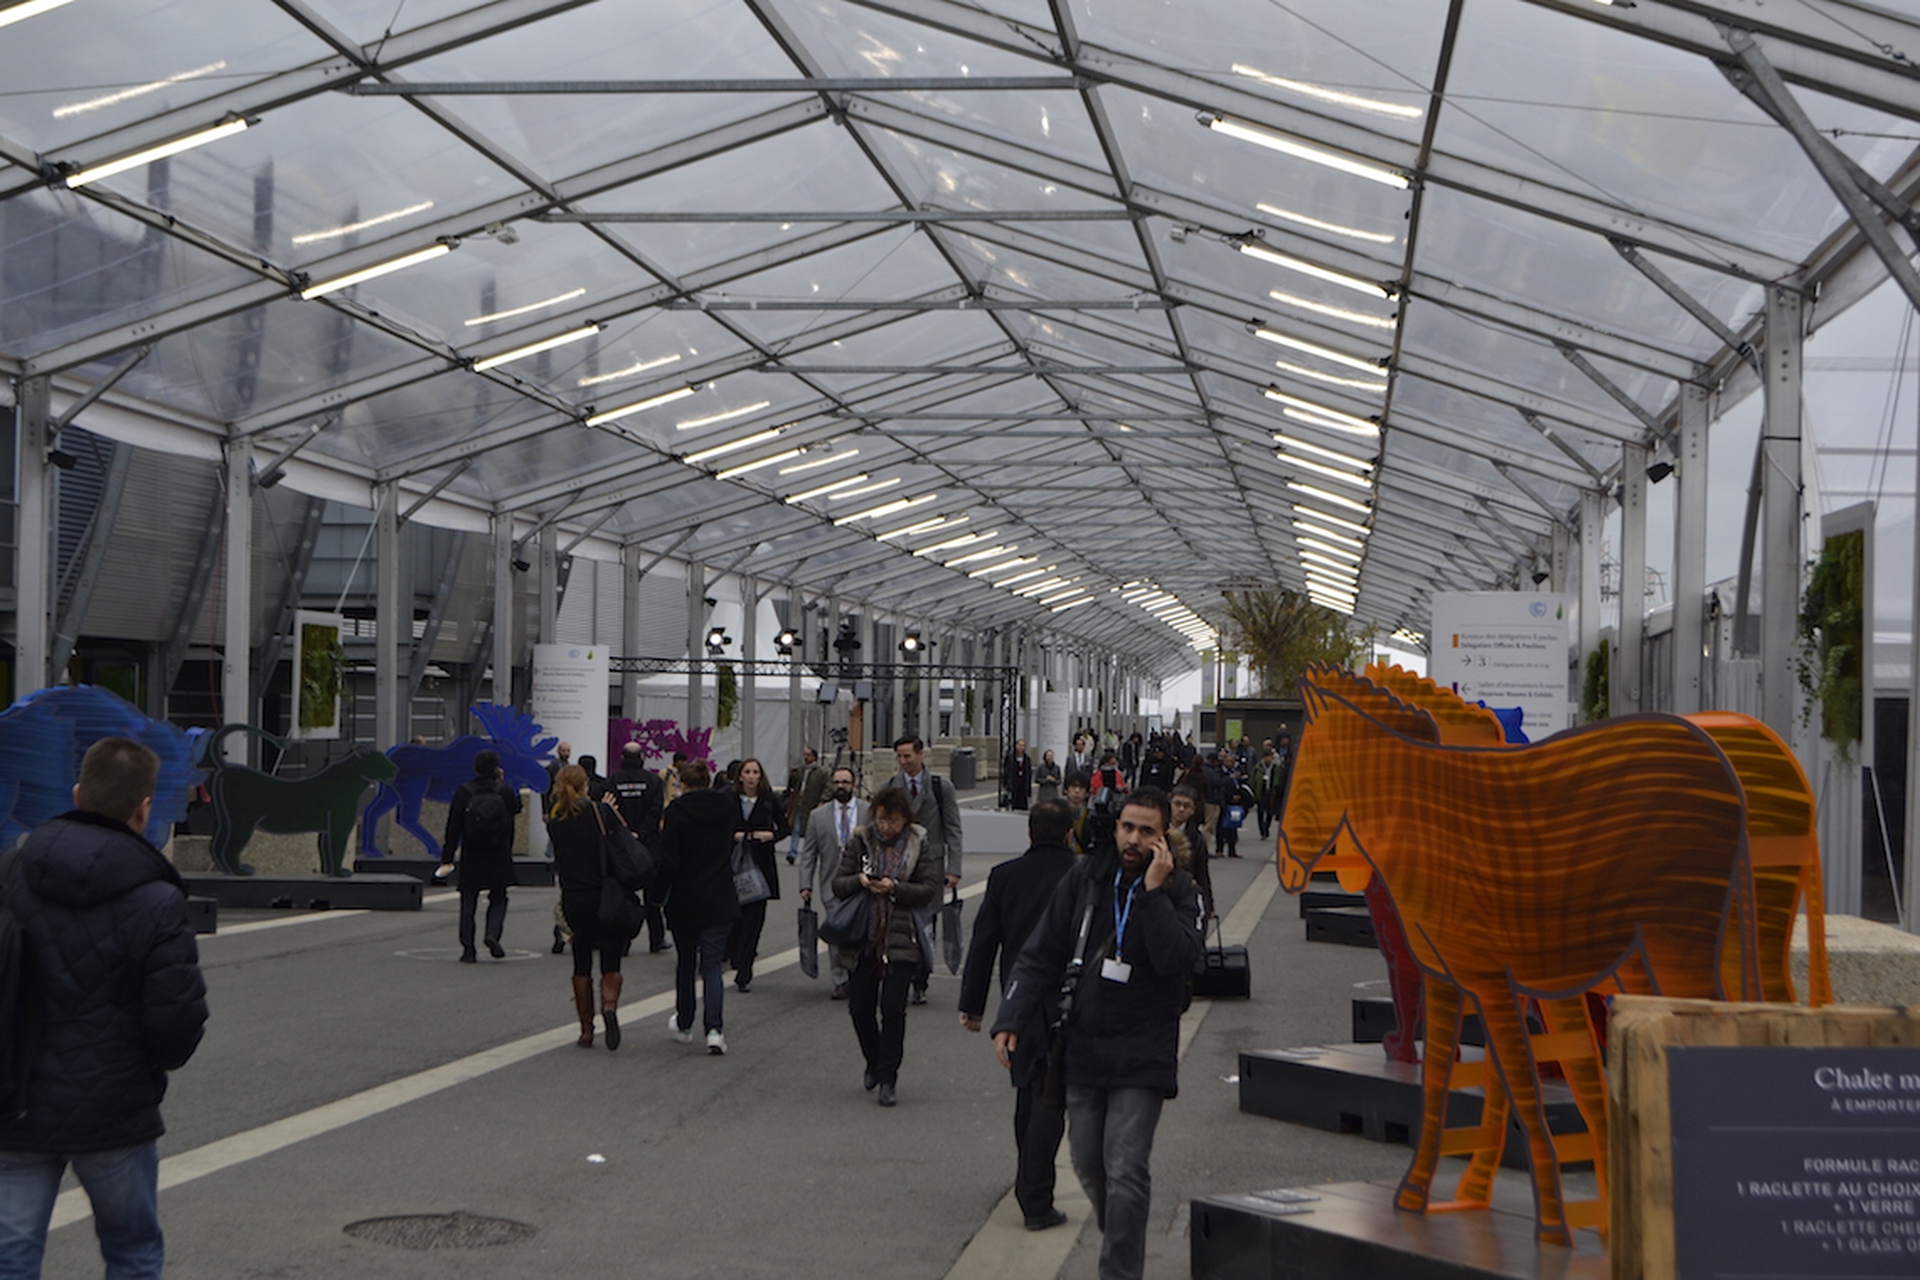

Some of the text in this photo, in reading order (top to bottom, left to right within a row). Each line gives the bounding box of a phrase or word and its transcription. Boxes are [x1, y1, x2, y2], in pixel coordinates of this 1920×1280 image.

[1814, 1066, 1893, 1090] Chalet
[1803, 1158, 1882, 1174] FORMULE
[1736, 1181, 1920, 1198] 1 RACLETTE AU CHOIX
[1848, 1199, 1855, 1214] 1
[1859, 1199, 1915, 1215] VERRE
[1781, 1219, 1788, 1235] 1
[1793, 1219, 1877, 1235] RACLETTE
[1847, 1237, 1902, 1252] GLASS
[1906, 1238, 1920, 1253] O
